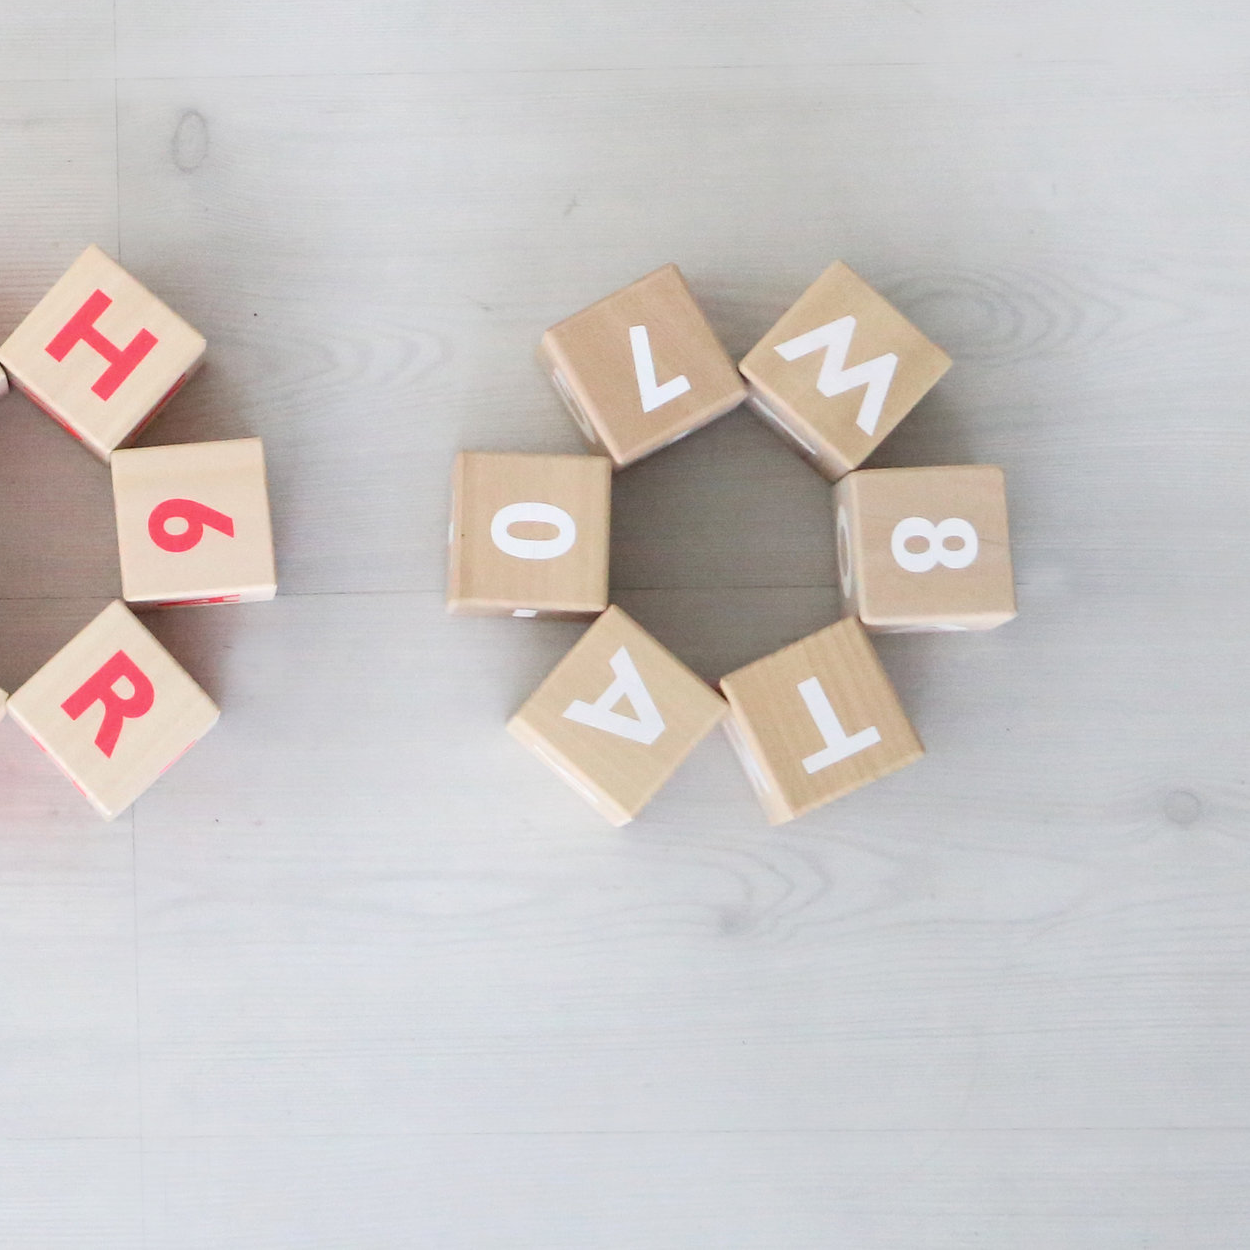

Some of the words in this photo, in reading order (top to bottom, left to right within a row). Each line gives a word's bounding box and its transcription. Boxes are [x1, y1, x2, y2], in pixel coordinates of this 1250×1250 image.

[45, 290, 158, 401] H
[892, 517, 978, 572] 8
[61, 650, 154, 758] R
[563, 647, 665, 745] A
[798, 677, 880, 773] T
